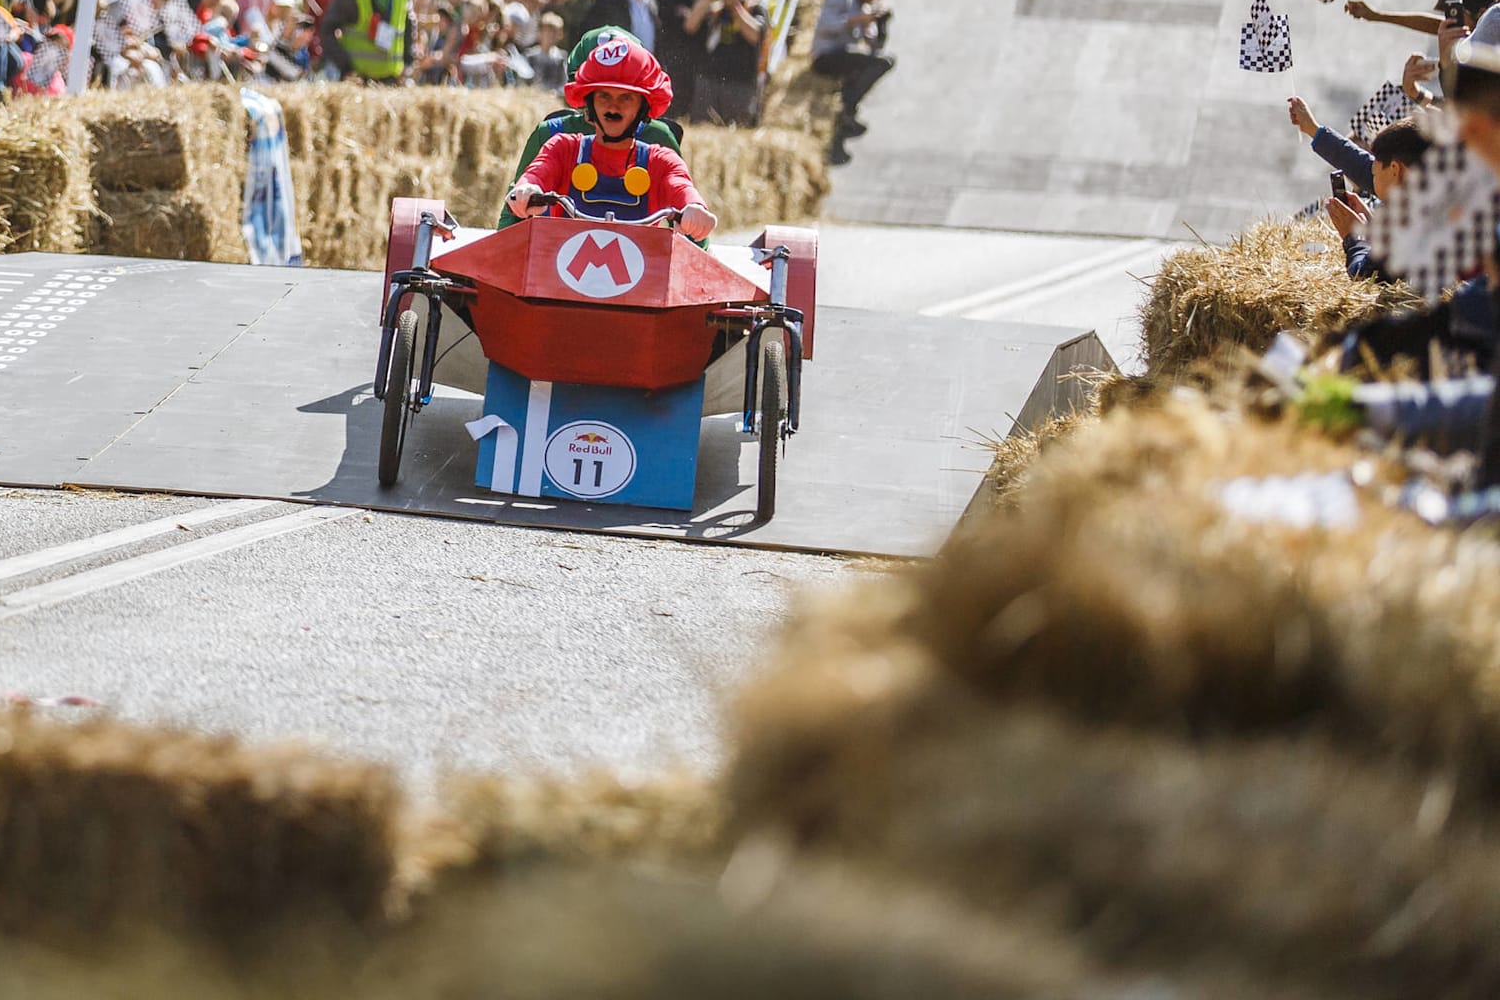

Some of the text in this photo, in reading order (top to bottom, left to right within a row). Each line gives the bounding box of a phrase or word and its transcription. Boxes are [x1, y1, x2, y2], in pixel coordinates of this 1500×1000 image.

[603, 46, 621, 61] M
[566, 233, 632, 286] M
[569, 443, 612, 456] Red Bull
[573, 458, 603, 487] 11
